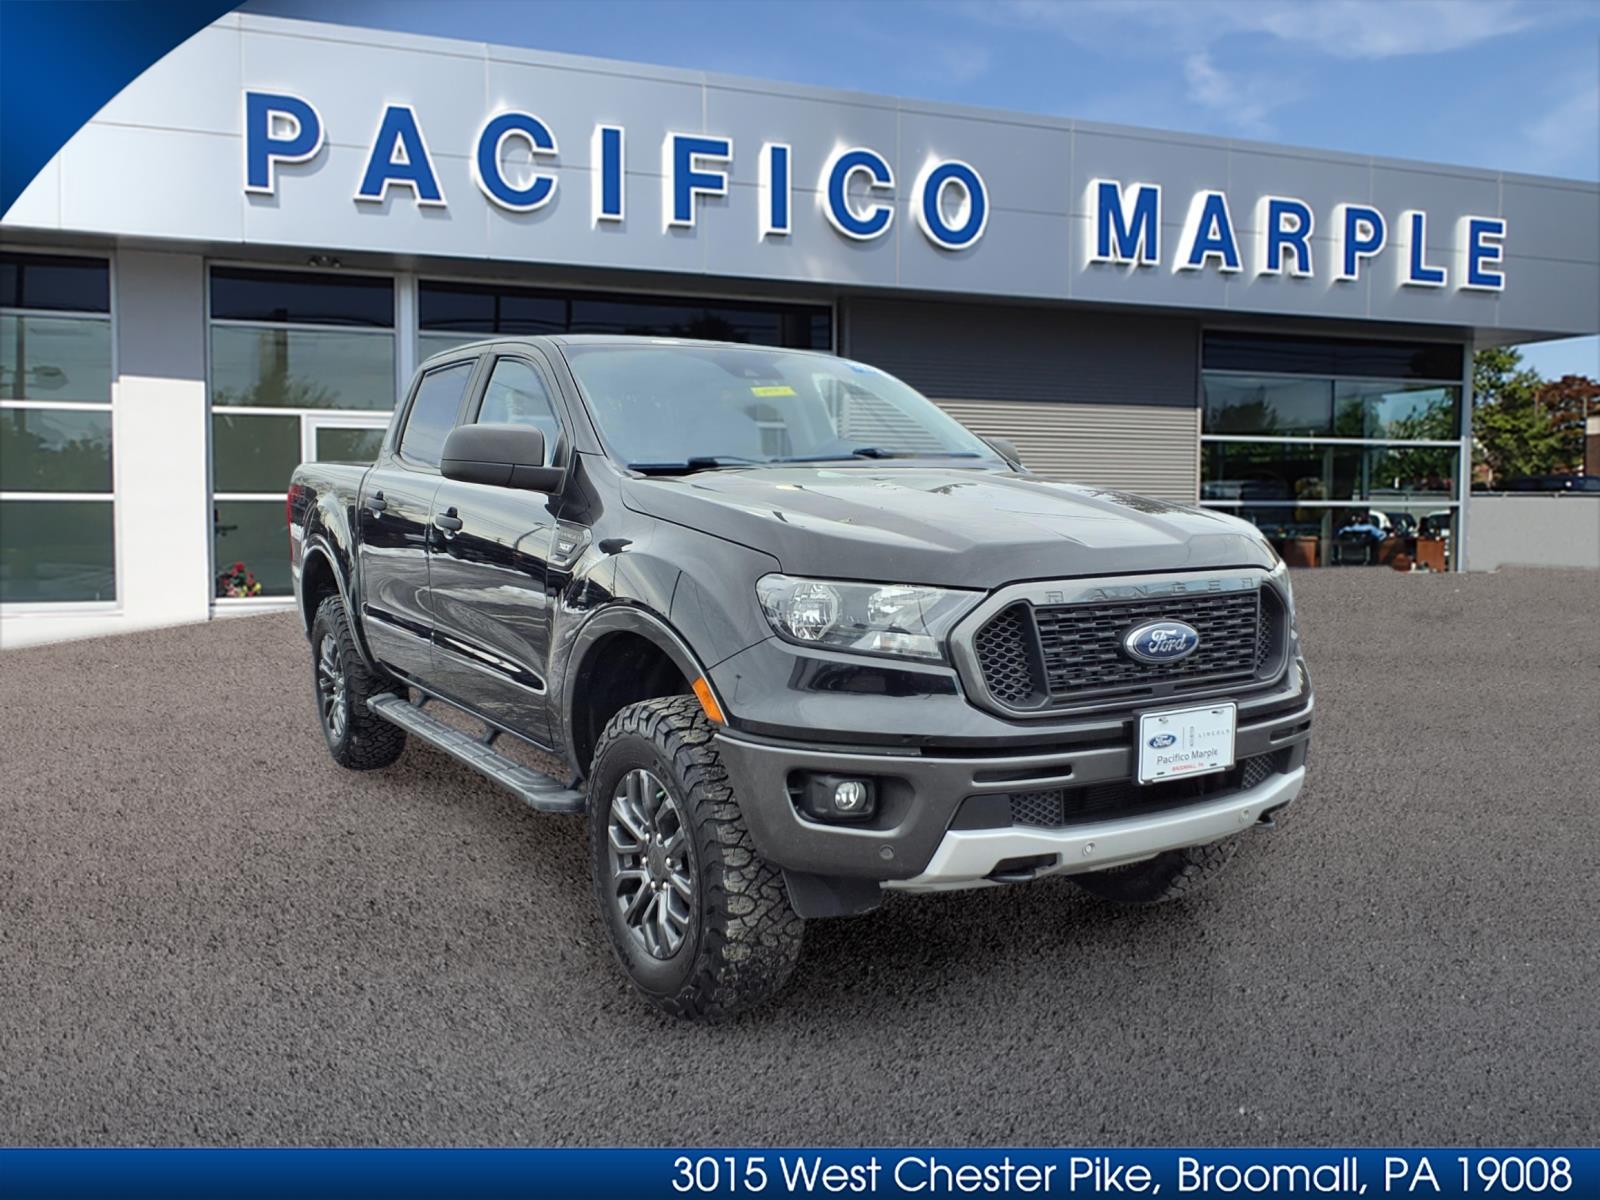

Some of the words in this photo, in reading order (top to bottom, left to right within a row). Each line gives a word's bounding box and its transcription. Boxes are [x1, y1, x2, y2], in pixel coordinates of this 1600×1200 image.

[243, 88, 989, 249] PACIFICO
[1087, 179, 1507, 292] MARPLE
[1044, 577, 1254, 604] RANGER
[1148, 628, 1187, 654] Ford
[1156, 752, 1191, 765] Pacifico
[1191, 747, 1219, 760] Marple
